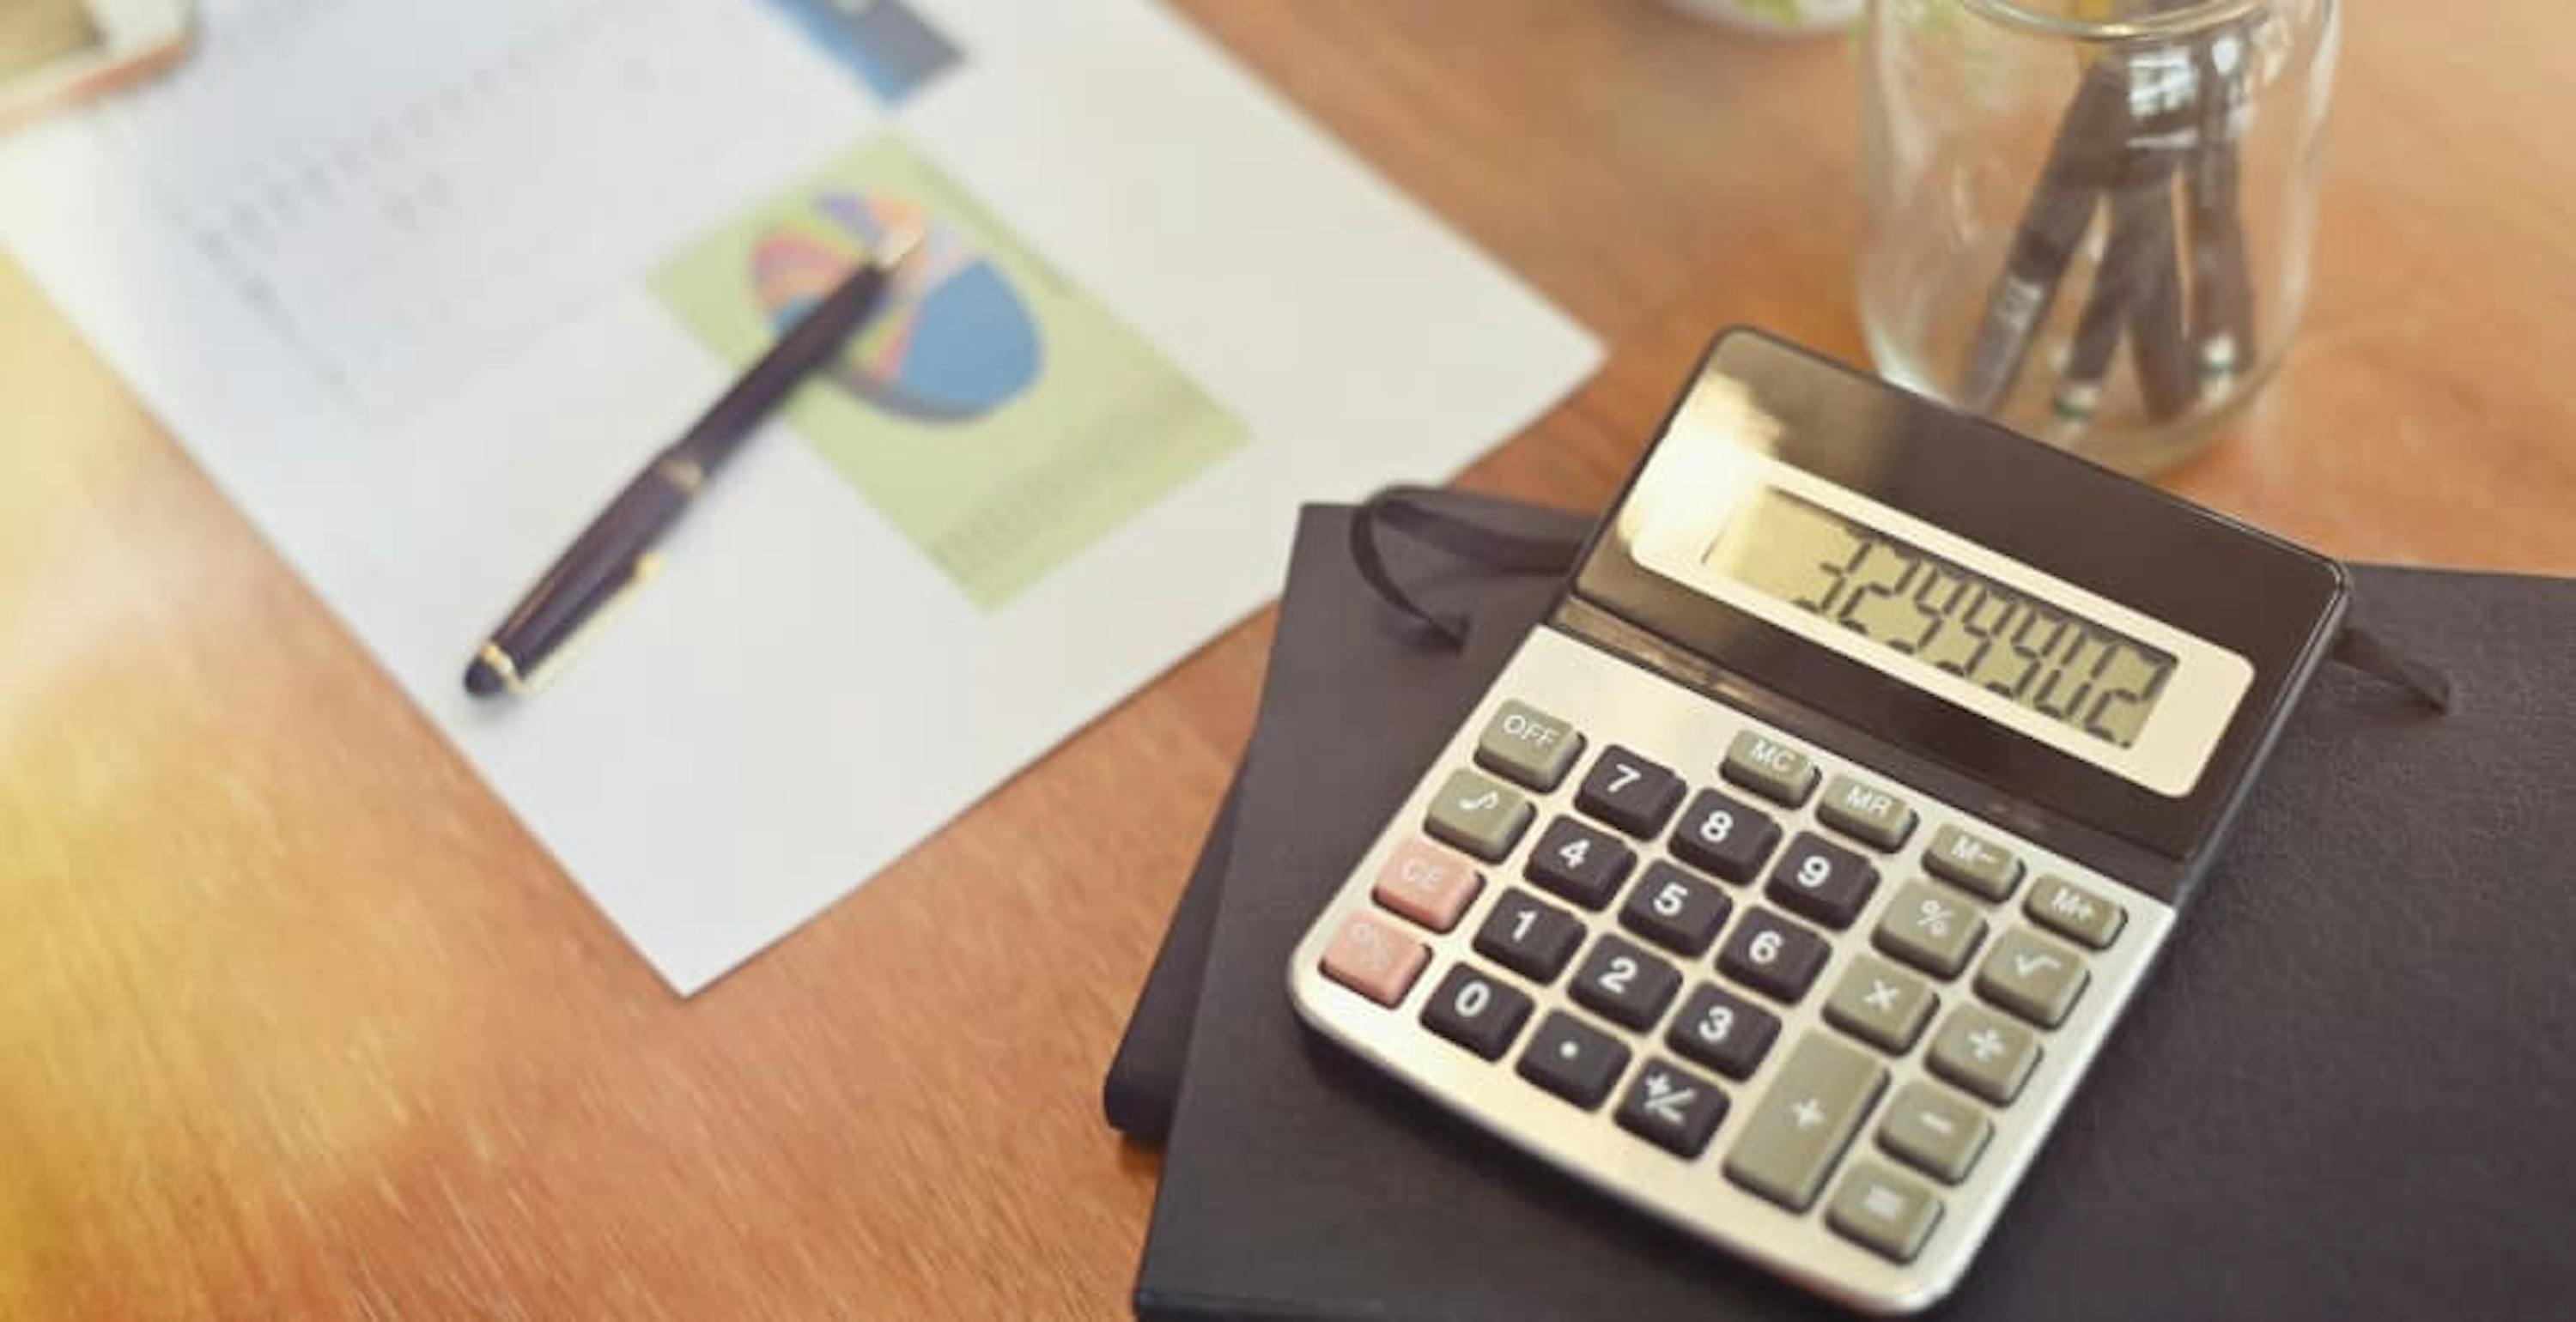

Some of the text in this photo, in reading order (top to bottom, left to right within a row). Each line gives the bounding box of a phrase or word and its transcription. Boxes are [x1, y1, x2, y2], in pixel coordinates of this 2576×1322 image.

[1503, 715, 1563, 745] OFF
[1752, 737, 1796, 772] MC
[1608, 763, 1642, 792] 7
[1845, 782, 1893, 816] MR
[1700, 810, 1733, 842] 8
[1559, 839, 1590, 868] 4
[1797, 856, 1831, 888] 9
[1653, 882, 1688, 916] 5
[1513, 911, 1537, 940] 1
[1749, 931, 1783, 963] 6
[1599, 957, 1637, 993] 2
[1455, 981, 1490, 1017] 0
[1699, 1006, 1734, 1042] 3
